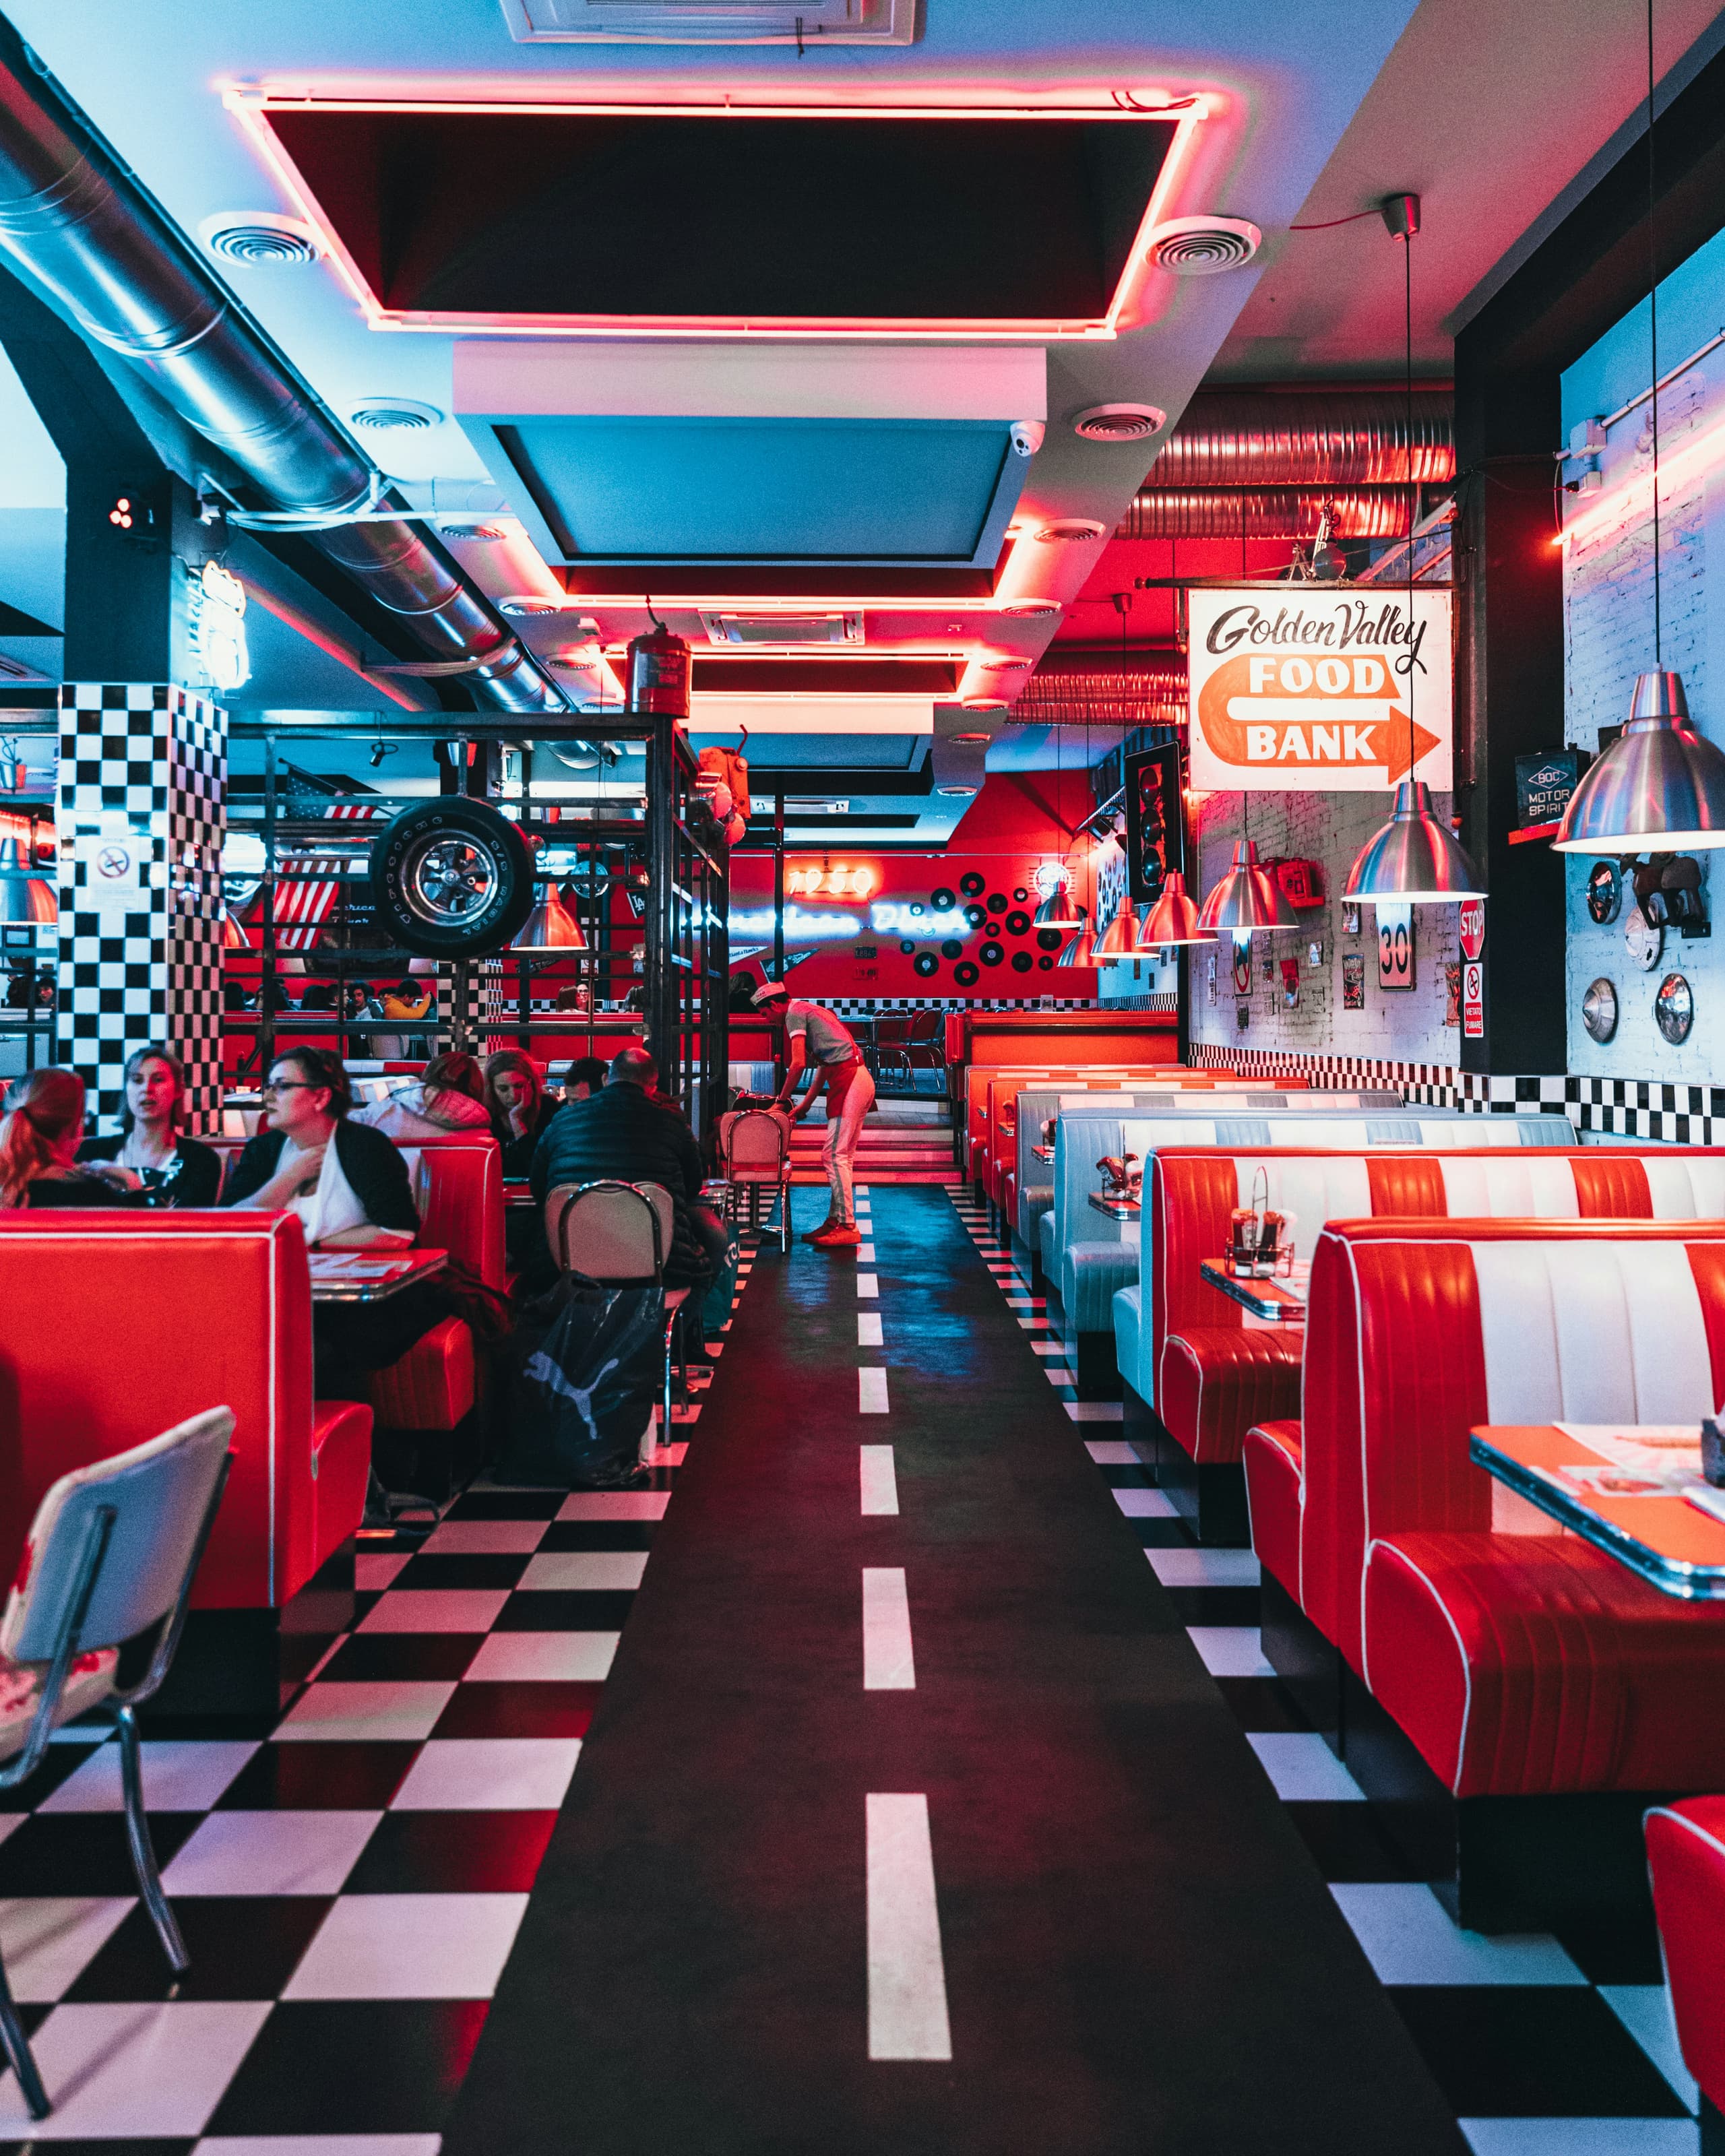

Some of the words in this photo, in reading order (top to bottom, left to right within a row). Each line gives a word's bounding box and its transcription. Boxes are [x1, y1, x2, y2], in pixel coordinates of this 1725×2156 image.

[1206, 605, 1337, 654] Golden
[1335, 600, 1428, 675] Valley
[1249, 658, 1385, 694] FOOD
[1247, 725, 1378, 761] BANK
[1528, 789, 1571, 803] MOTOR
[1529, 802, 1569, 816] SPIRIT
[789, 868, 873, 894] 1950
[1461, 910, 1483, 937] STOP
[1381, 923, 1408, 974] 30
